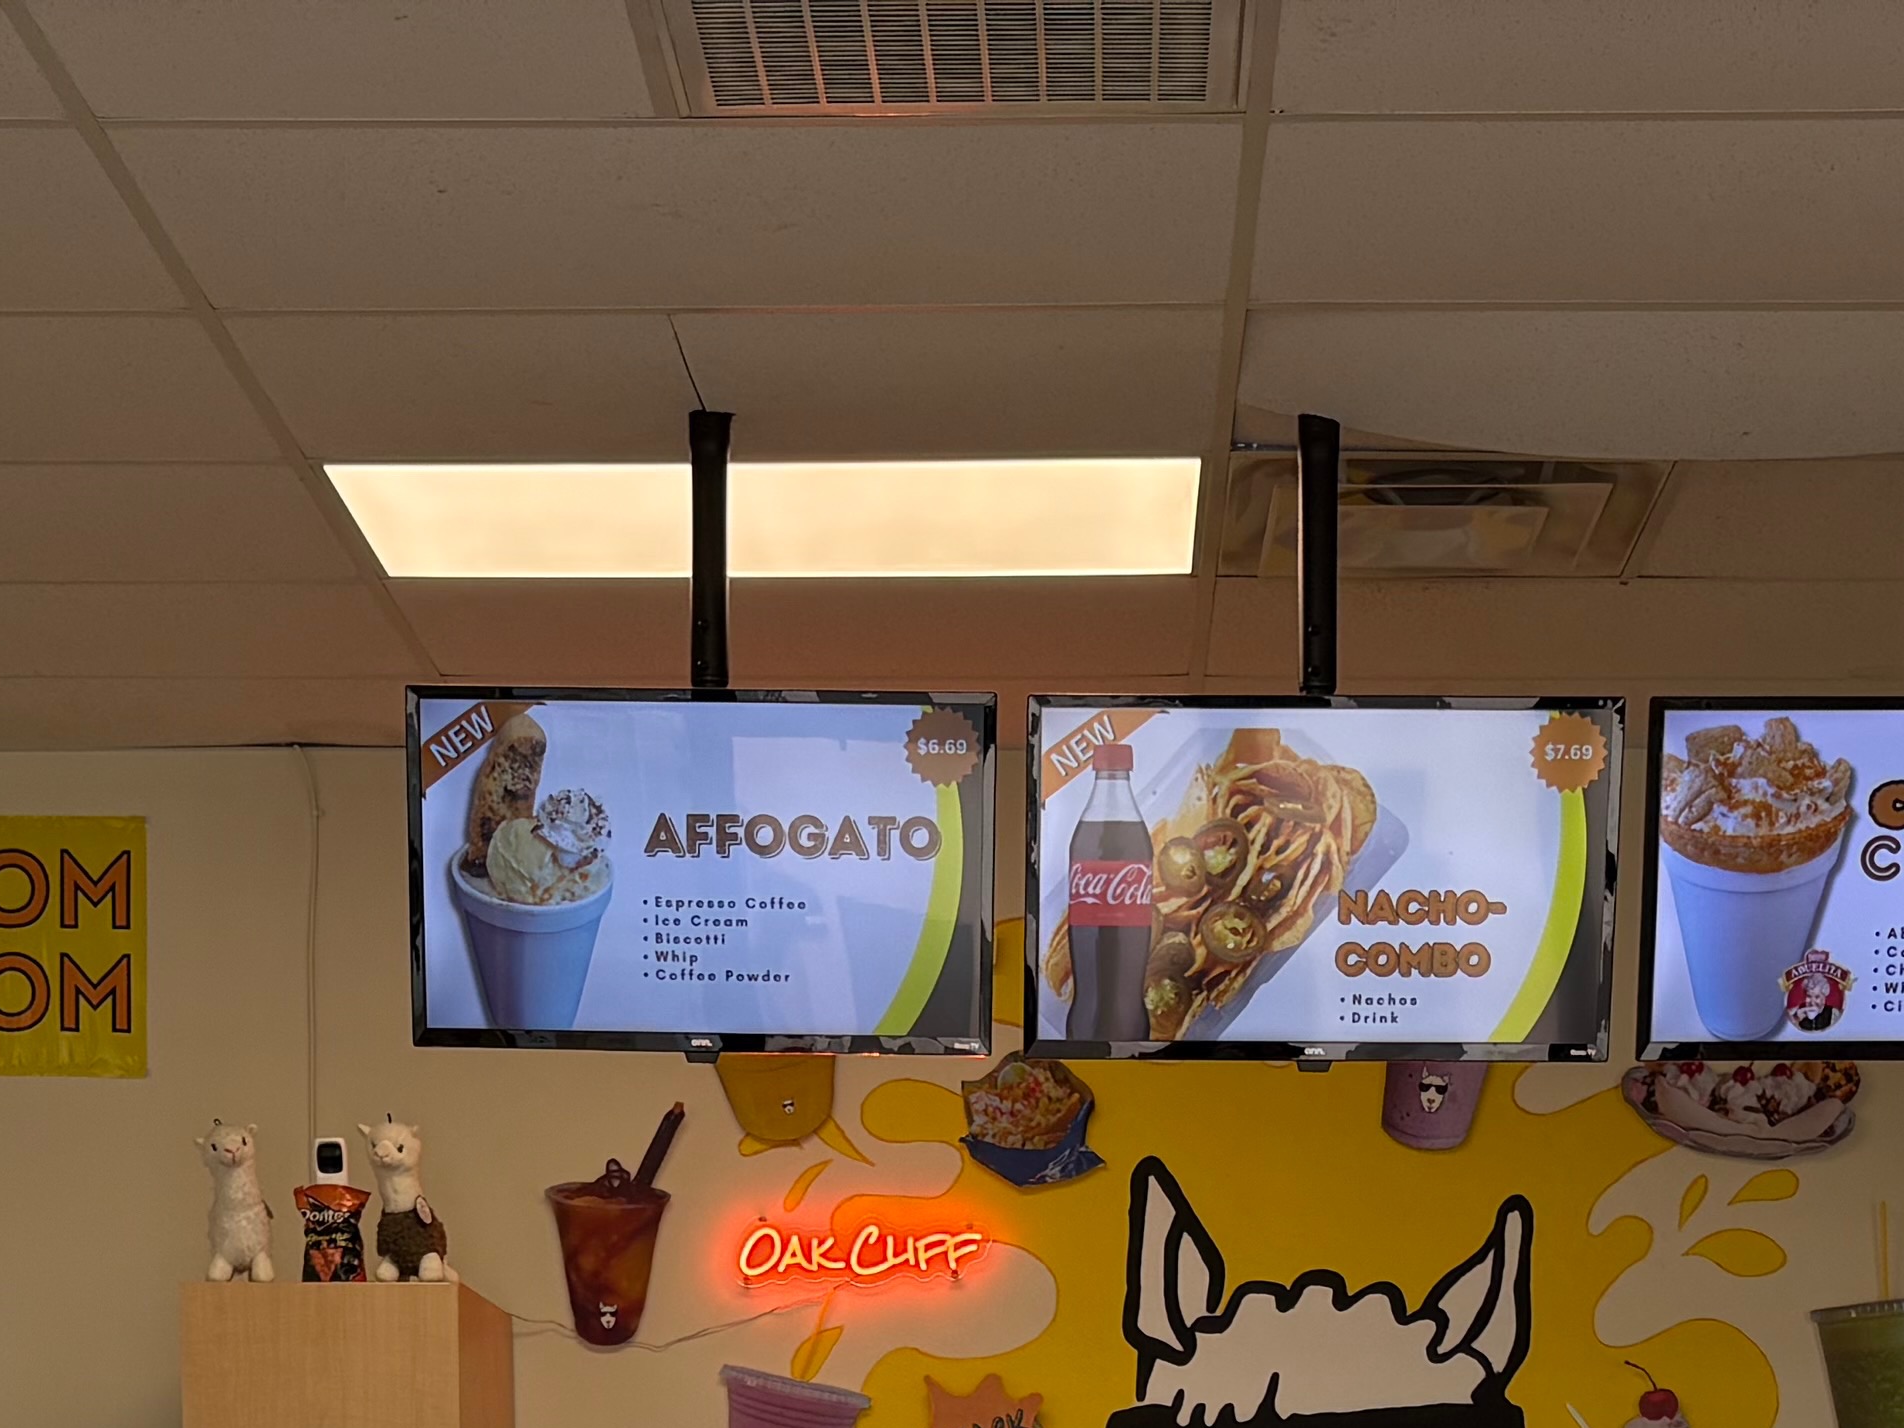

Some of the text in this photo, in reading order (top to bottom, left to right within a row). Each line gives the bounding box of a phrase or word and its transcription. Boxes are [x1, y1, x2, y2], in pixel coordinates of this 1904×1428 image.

[429, 706, 495, 767] NEW
[1049, 714, 1117, 777] NEW
[916, 737, 968, 757] $6.69
[1544, 741, 1594, 763] $7.69
[644, 812, 943, 861] AFFOGATO
[654, 896, 806, 913] Espresso Coffee
[1336, 889, 1508, 928] NACHO-
[654, 915, 749, 928] Ice Cream
[654, 932, 726, 946] Biscotti
[654, 950, 700, 967] Whip
[1335, 941, 1492, 979] COMBO
[655, 968, 792, 984] Coffee Powder
[1352, 993, 1418, 1008] Nachos
[1352, 1010, 1399, 1025] Drink
